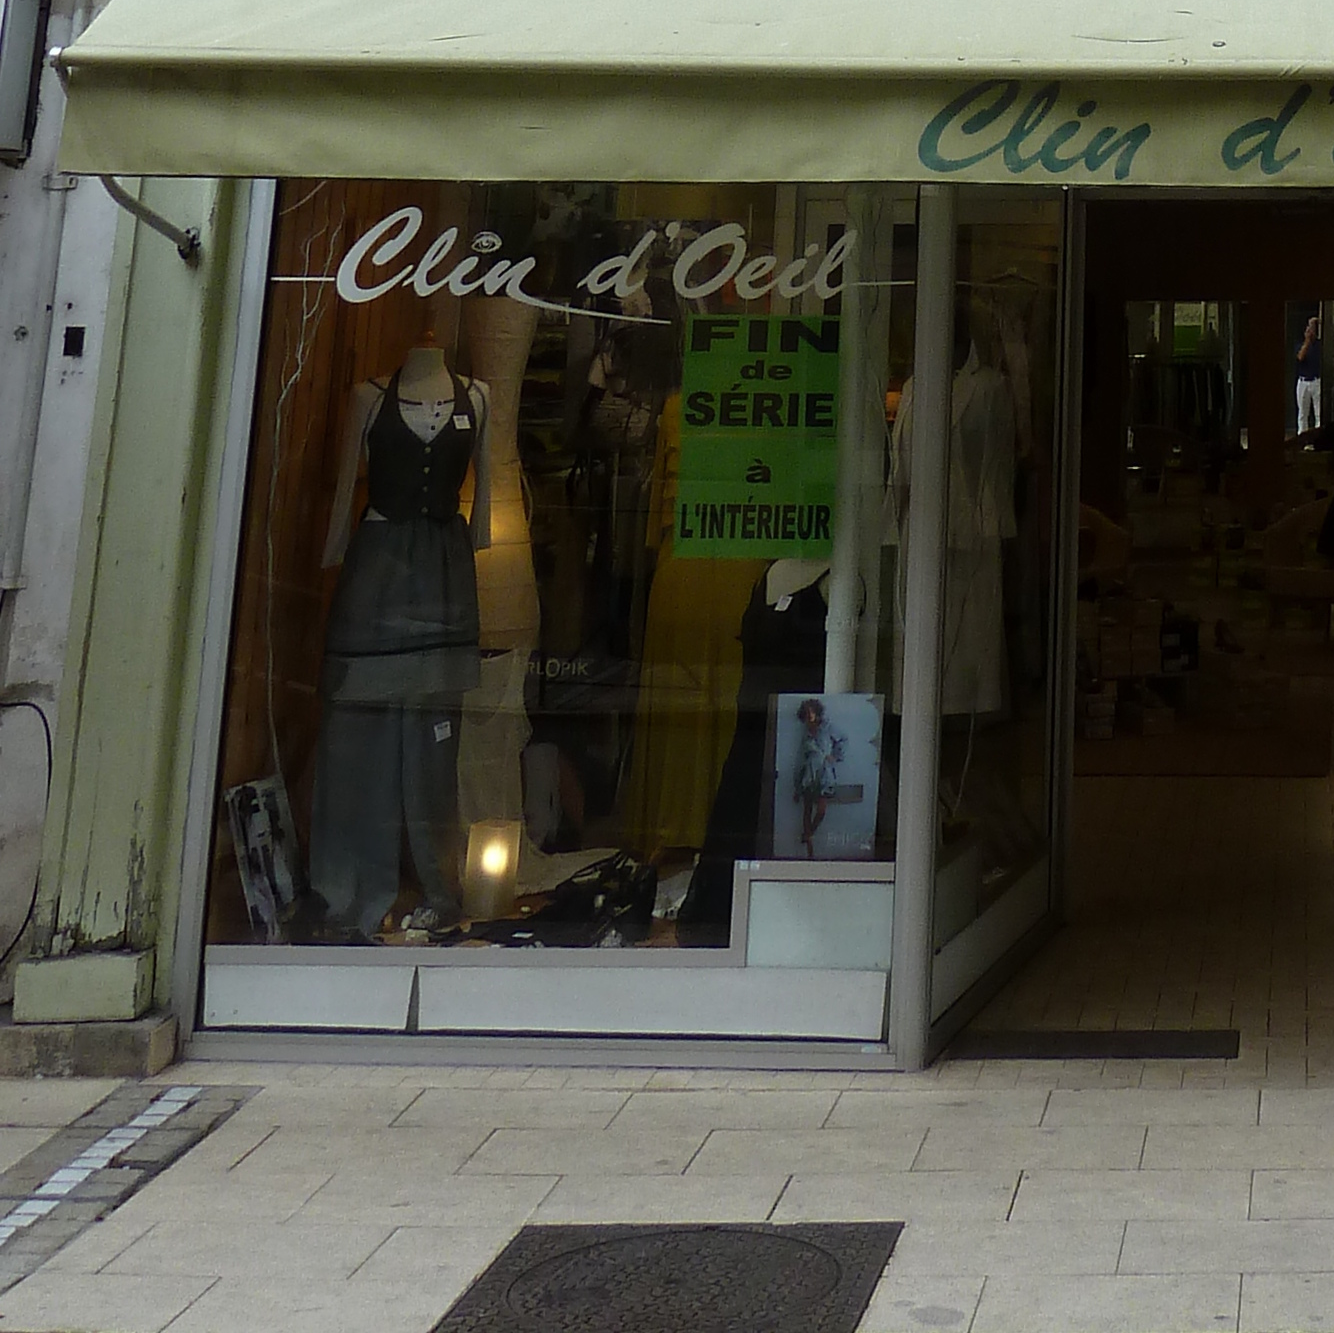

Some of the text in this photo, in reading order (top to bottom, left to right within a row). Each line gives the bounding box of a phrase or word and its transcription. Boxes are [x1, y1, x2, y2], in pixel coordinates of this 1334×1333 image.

[918, 79, 1151, 181] Clin
[577, 222, 857, 301] d'Oeil
[690, 318, 840, 354] FIN
[740, 359, 793, 381] de
[685, 383, 835, 428] SÉRIE
[745, 458, 772, 484] à
[679, 496, 831, 541] L'INTÉRIEUR
